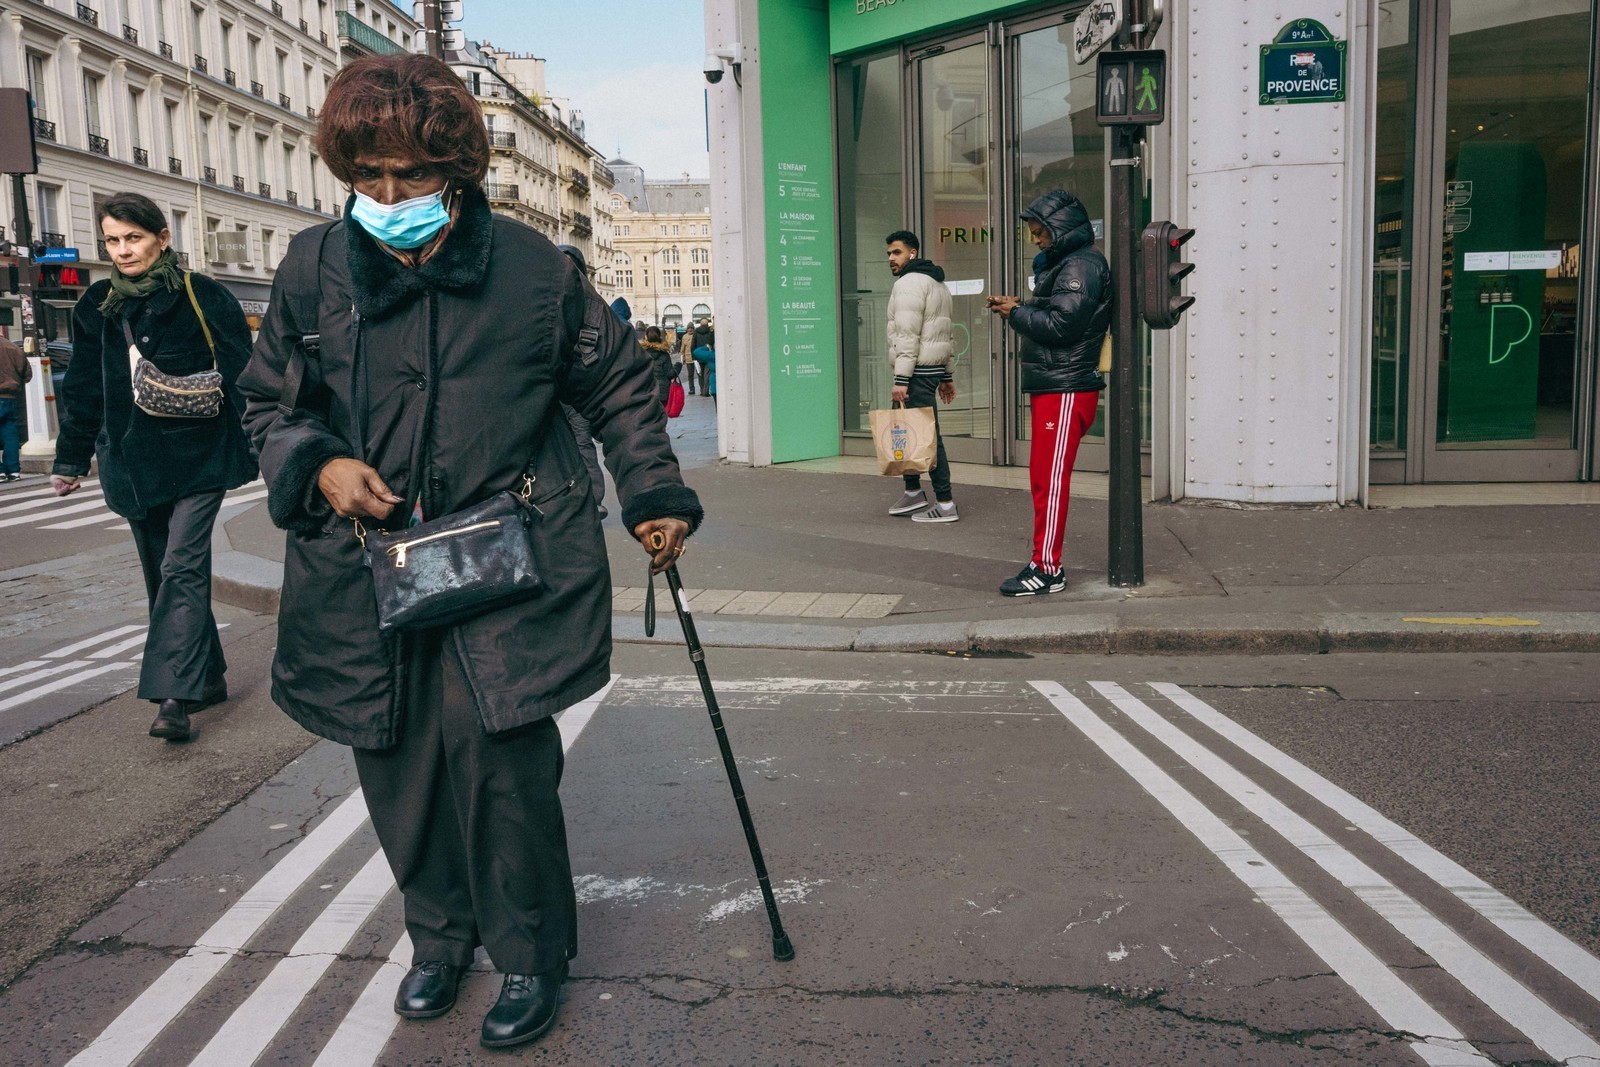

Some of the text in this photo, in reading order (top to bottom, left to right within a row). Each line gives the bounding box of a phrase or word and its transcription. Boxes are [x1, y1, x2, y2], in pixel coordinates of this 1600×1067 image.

[1267, 78, 1338, 93] PROVENCE
[778, 163, 807, 172] L'ENFANT
[779, 185, 786, 197] 5
[779, 212, 815, 221] LA MAISON
[779, 234, 787, 246] 4
[219, 243, 246, 251] EDEN
[780, 255, 787, 266] 3
[780, 275, 787, 287] 2
[243, 302, 264, 312] EDEN
[791, 300, 816, 309] BEAUTÉ
[783, 323, 789, 335] 1
[783, 344, 790, 356] 0
[781, 364, 790, 376] -1
